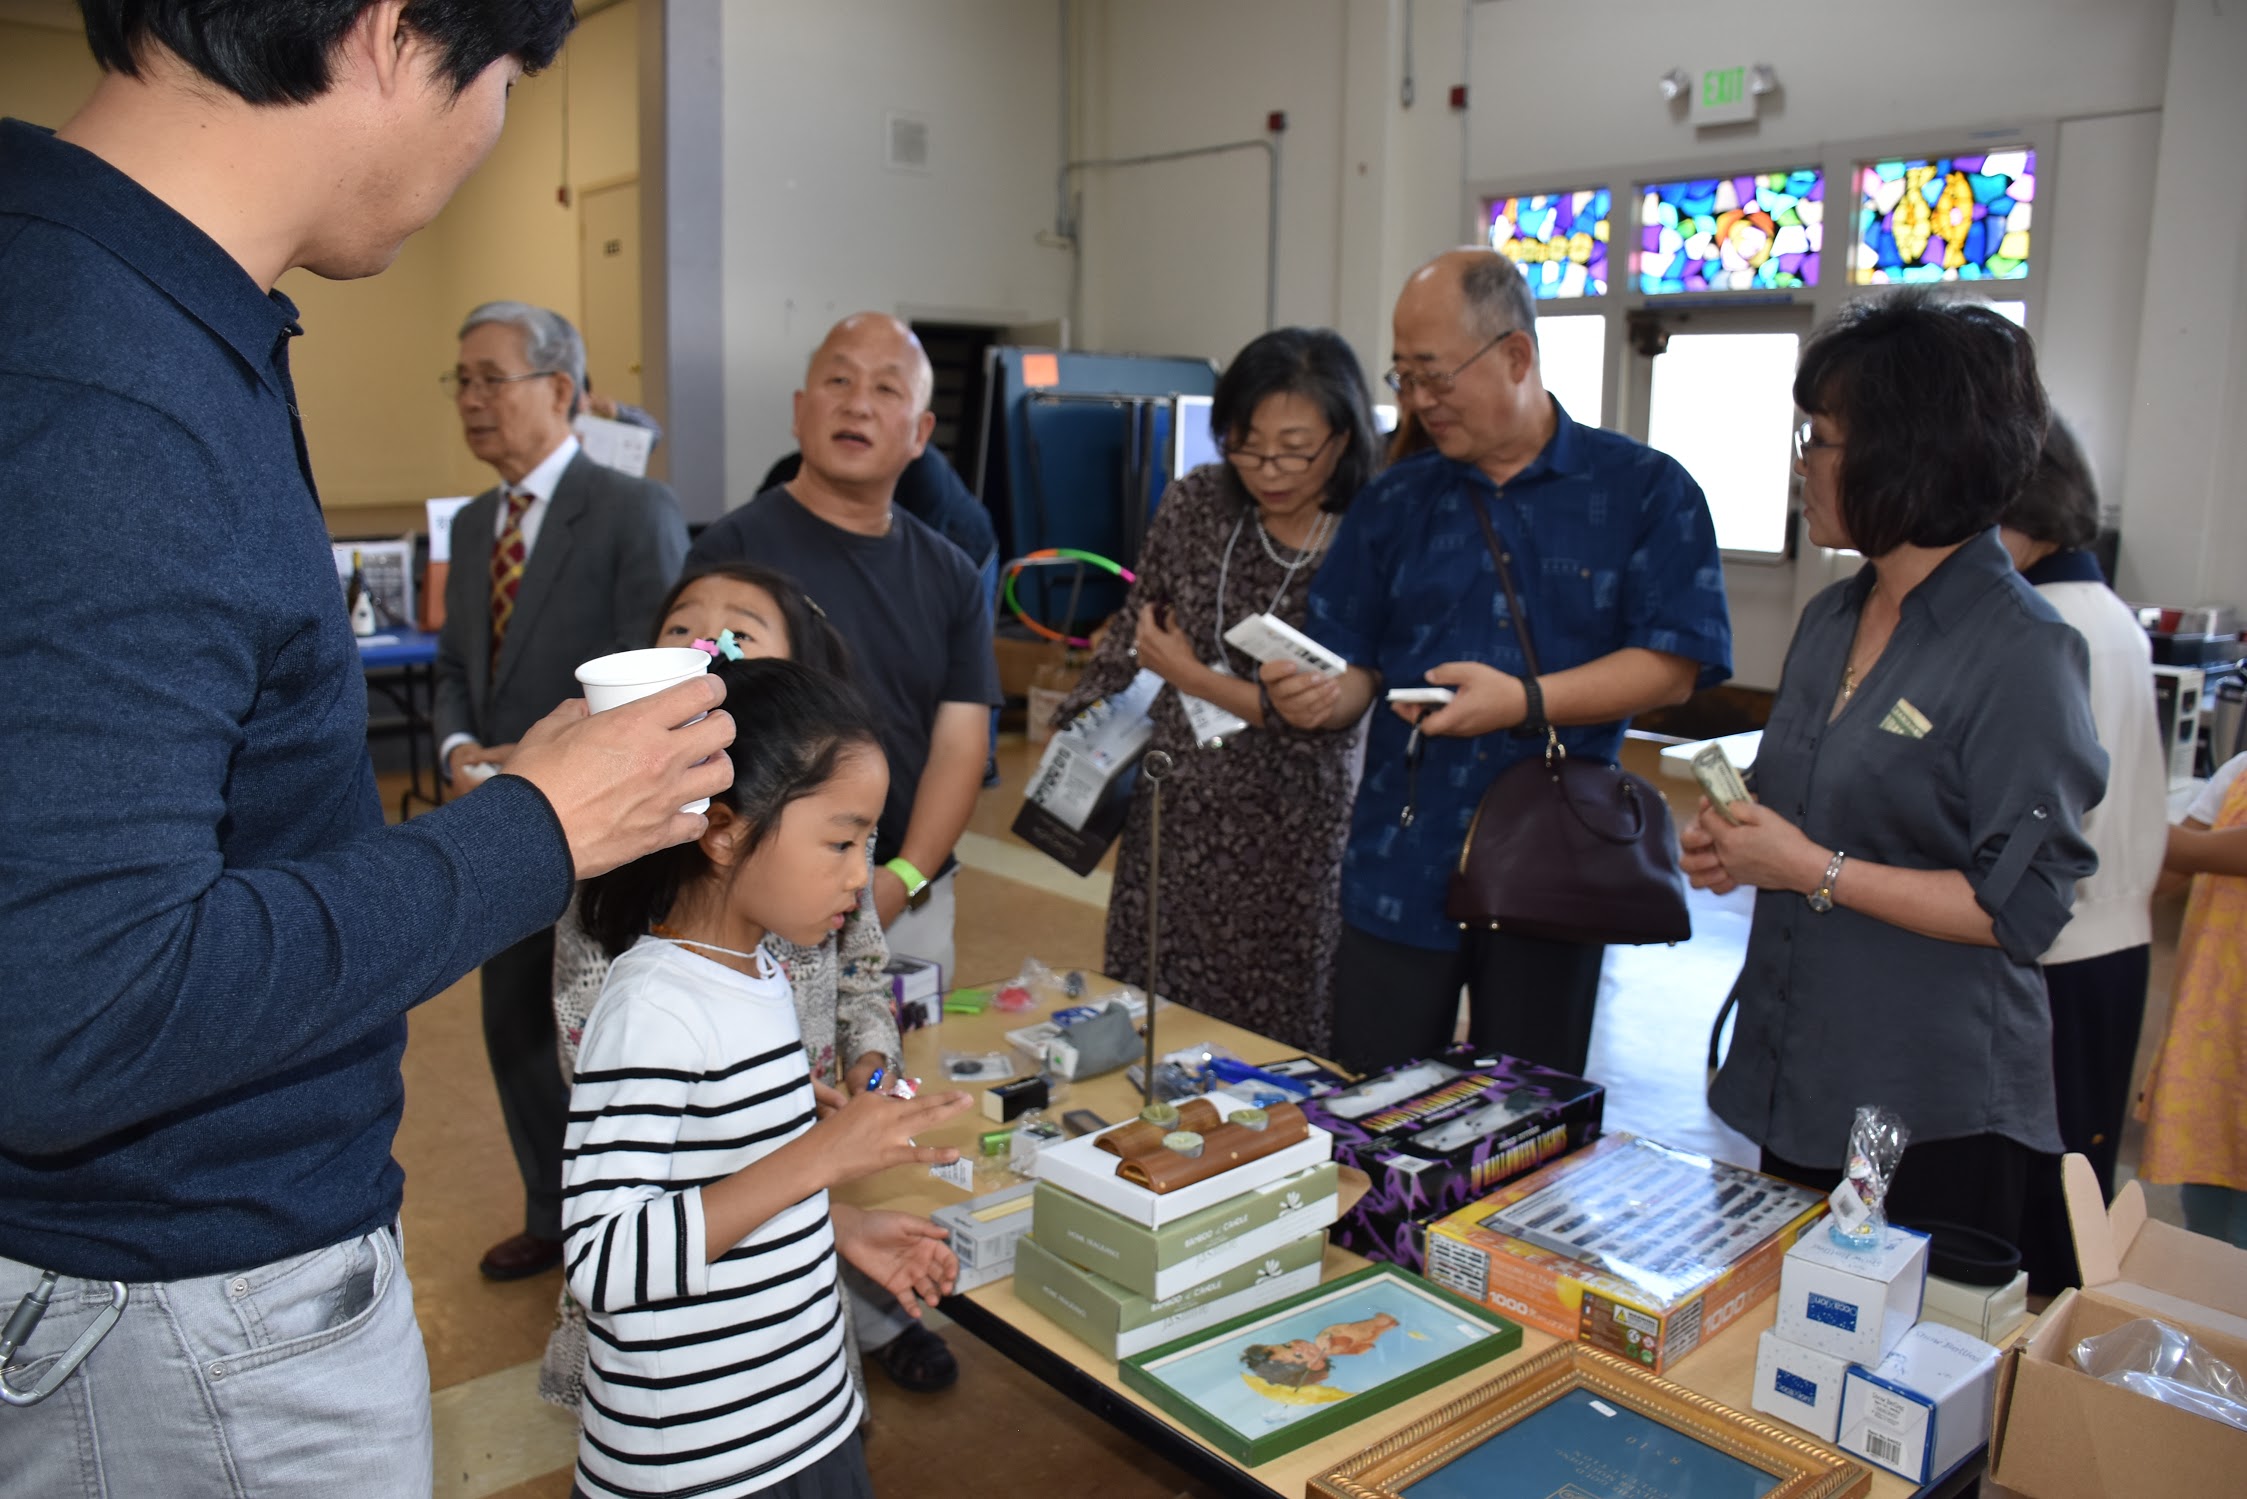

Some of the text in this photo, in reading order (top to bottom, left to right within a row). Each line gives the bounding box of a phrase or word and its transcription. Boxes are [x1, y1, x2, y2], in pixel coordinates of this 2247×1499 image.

[1702, 65, 1745, 108] EXIT
[1223, 1214, 1249, 1232] CANDLE
[1489, 1290, 1528, 1315] 1000
